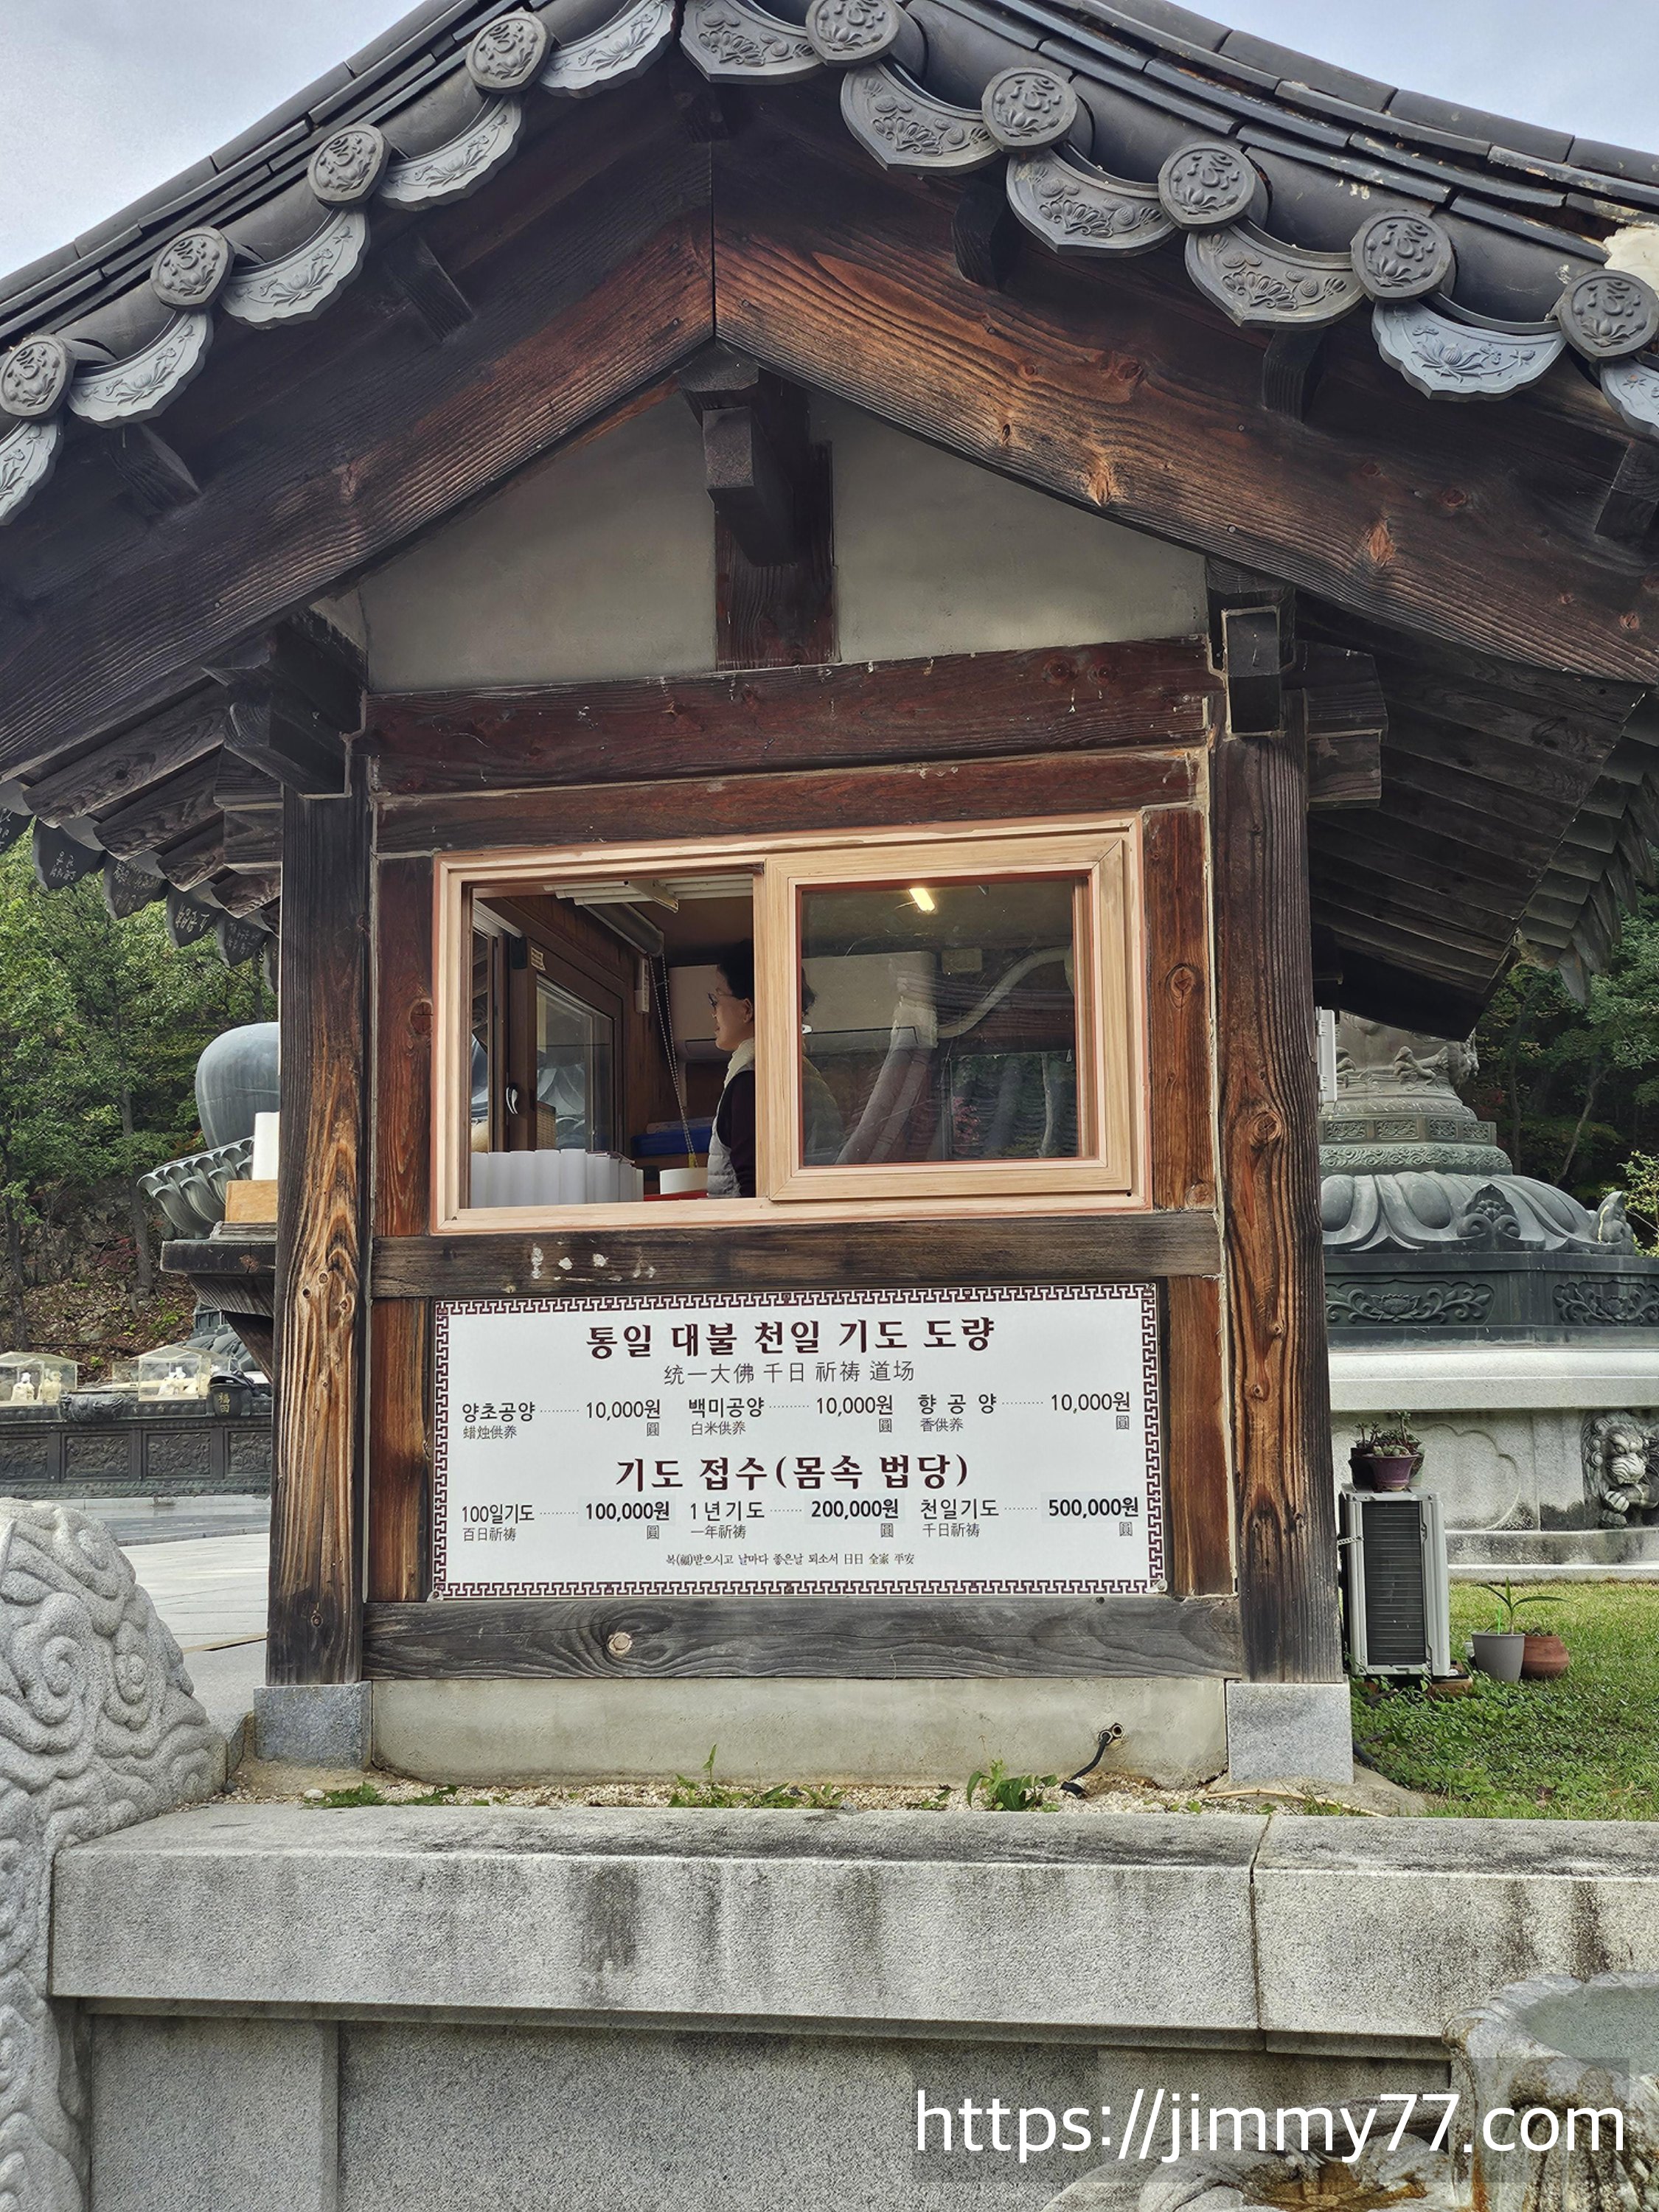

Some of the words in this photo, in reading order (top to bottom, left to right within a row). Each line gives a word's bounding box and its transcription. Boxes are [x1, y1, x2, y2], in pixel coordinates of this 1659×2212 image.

[585, 1323, 652, 1360] 통일
[670, 1322, 737, 1357] 대불
[754, 1320, 819, 1354] 천일
[838, 1318, 908, 1354] 기도
[923, 1316, 995, 1352] 도량
[664, 1363, 755, 1386] 统一大佛
[763, 1361, 804, 1384] 千日
[815, 1360, 860, 1383] 祈祷
[869, 1360, 915, 1382] 道场
[462, 1401, 536, 1424] 양초공양
[586, 1399, 661, 1422] 10,000원
[689, 1396, 765, 1419] 백미공양
[816, 1394, 894, 1417] 10,000원
[1051, 1391, 1130, 1415] 10,000원
[691, 1420, 747, 1436] 白米供养
[919, 1417, 964, 1433] 香供养
[616, 1458, 684, 1492] 기도
[879, 1453, 968, 1489] 법당)
[462, 1503, 535, 1525] 100일기도
[585, 1500, 671, 1523] 100,000원
[811, 1498, 900, 1521] 200,000원
[919, 1498, 1000, 1520] 천일기도
[1048, 1496, 1140, 1520] 500,000원
[462, 1527, 517, 1543] 百日祈祷
[690, 1524, 747, 1540] 一年祈祷
[922, 1522, 981, 1539] 千日祈祷
[738, 1553, 769, 1565] 날마다
[773, 1553, 804, 1566] 좋은날
[894, 1553, 915, 1565] 平安
